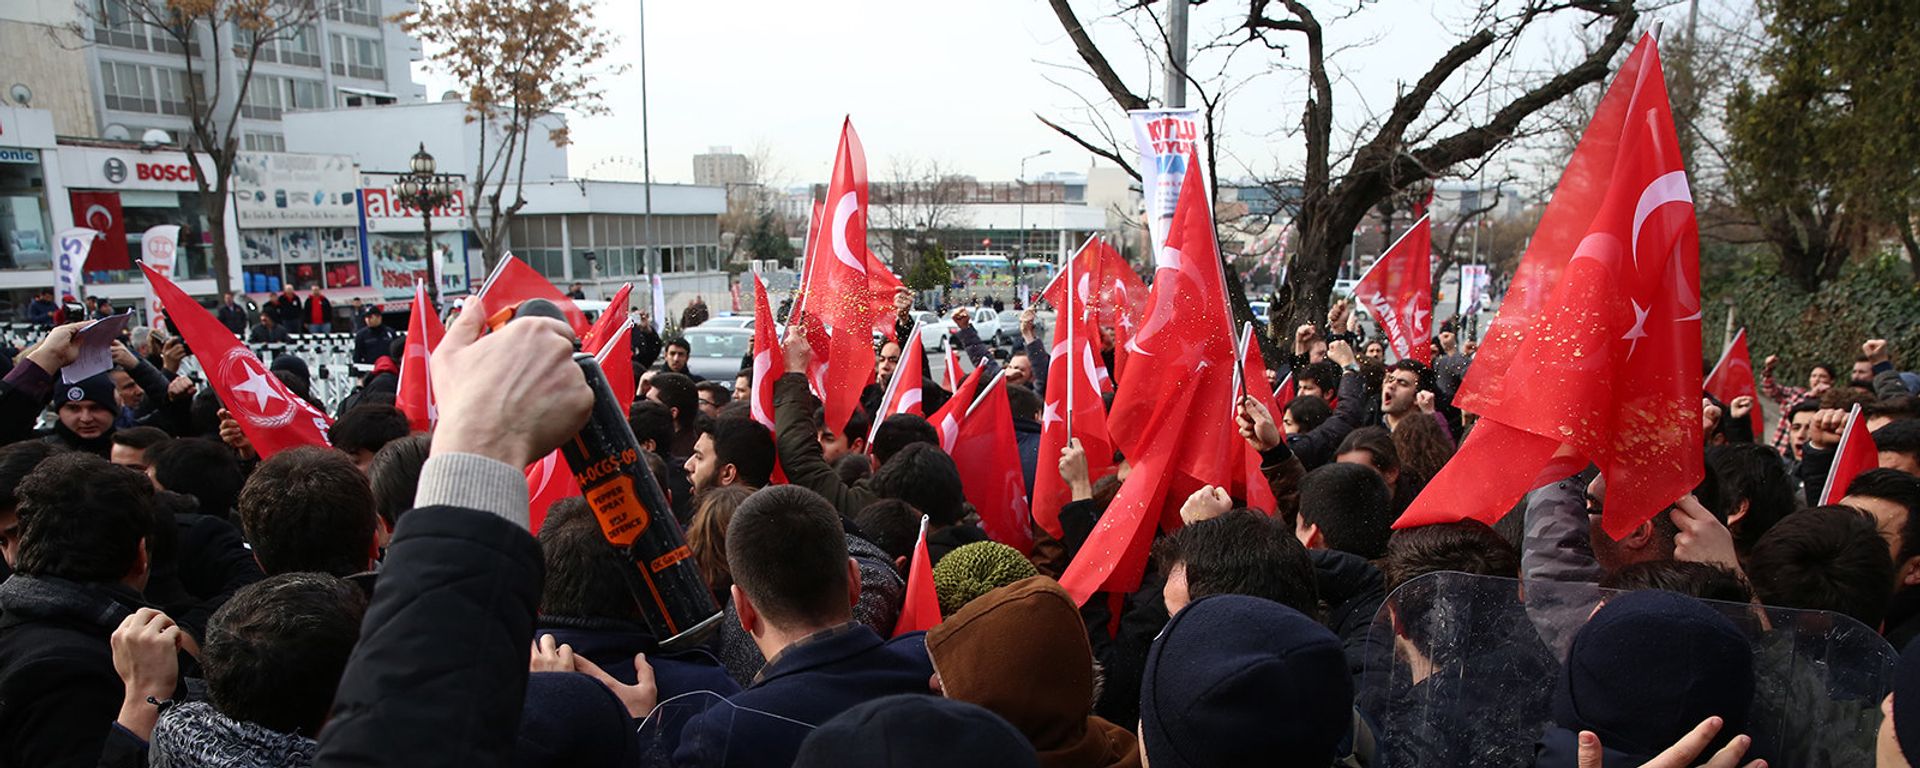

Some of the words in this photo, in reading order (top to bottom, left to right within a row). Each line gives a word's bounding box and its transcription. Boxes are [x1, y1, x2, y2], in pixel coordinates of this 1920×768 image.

[60, 237, 82, 295] LIPS
[1371, 290, 1401, 340] VATAN
[593, 486, 625, 506] PEPPER
[599, 496, 625, 514] SPRAY
[608, 517, 641, 538] DEFENCE
[609, 512, 628, 526] SELF
